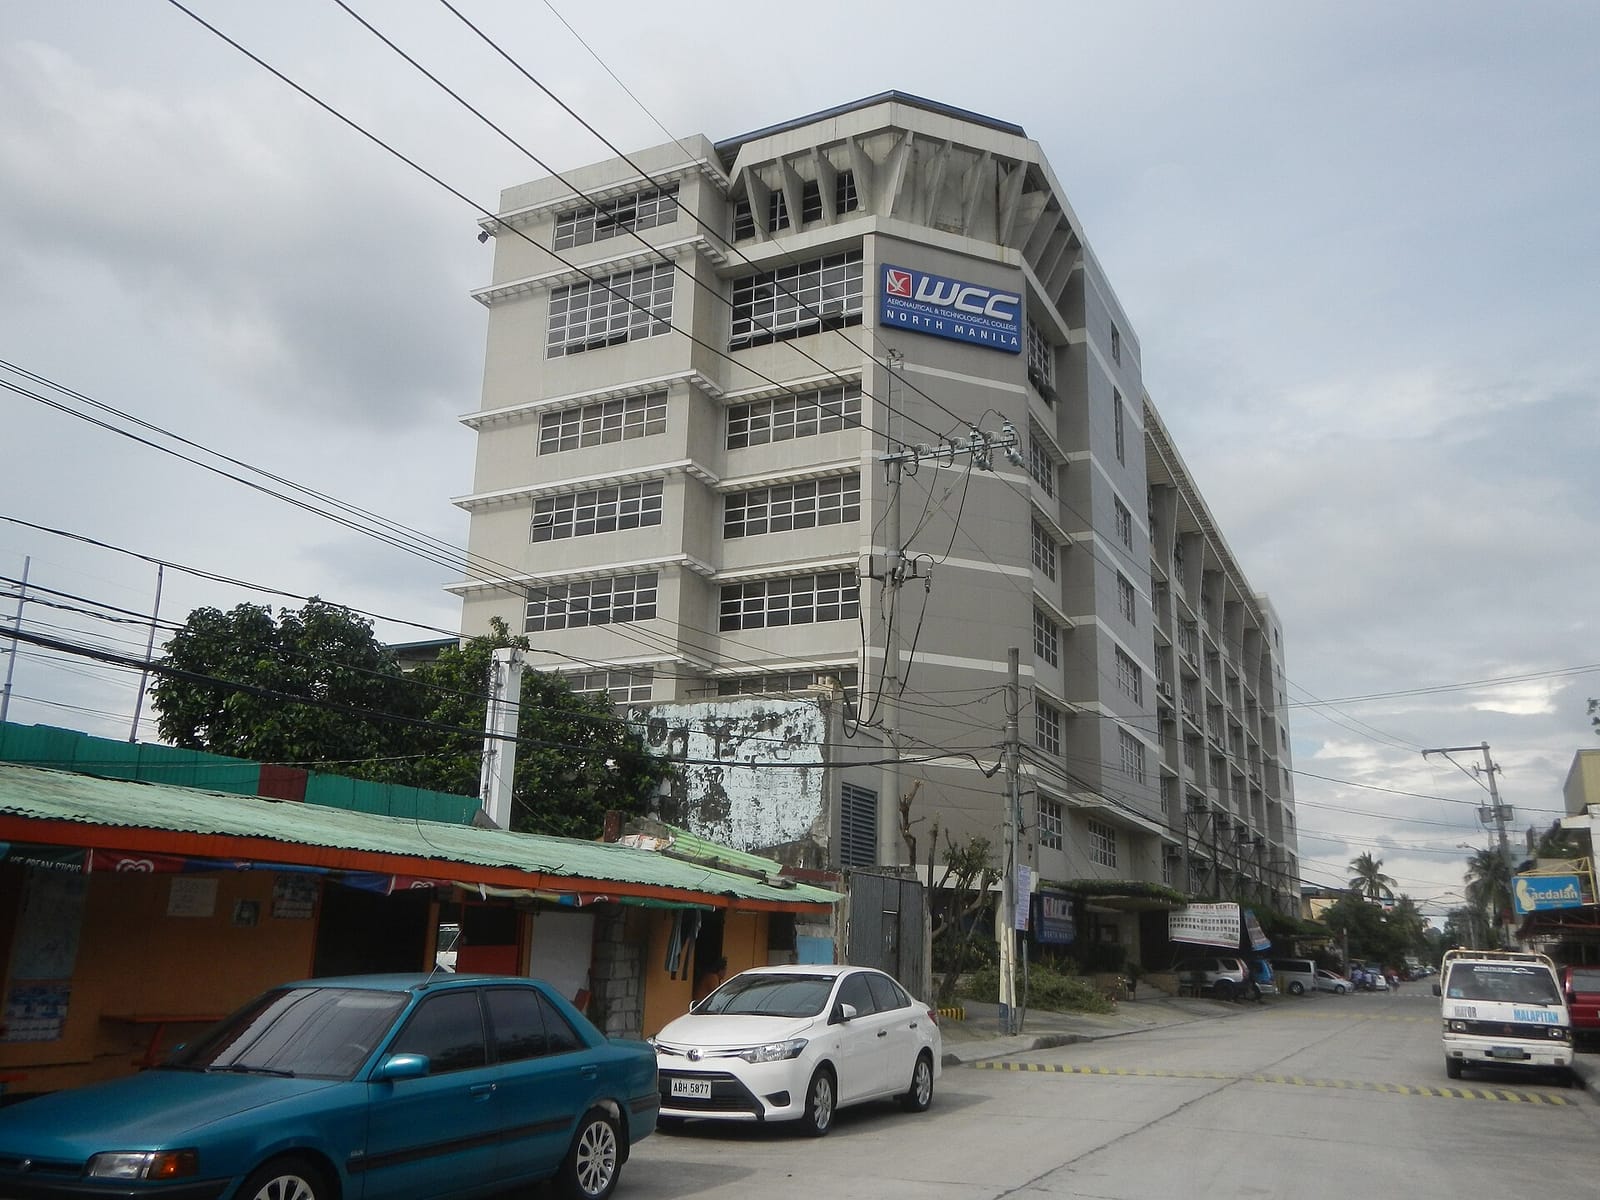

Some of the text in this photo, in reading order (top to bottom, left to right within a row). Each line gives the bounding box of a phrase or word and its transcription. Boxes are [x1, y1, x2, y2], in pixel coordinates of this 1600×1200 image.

[887, 297, 932, 315] AERONAUTICAL
[940, 310, 990, 326] TECHNOLOGICAL
[991, 320, 1017, 332] COLLEGE
[914, 276, 1019, 321] WCC
[886, 309, 1018, 346] NORTH MANILA
[1513, 1008, 1559, 1024] MALAPITAN
[674, 1082, 709, 1094] ABH 5877
